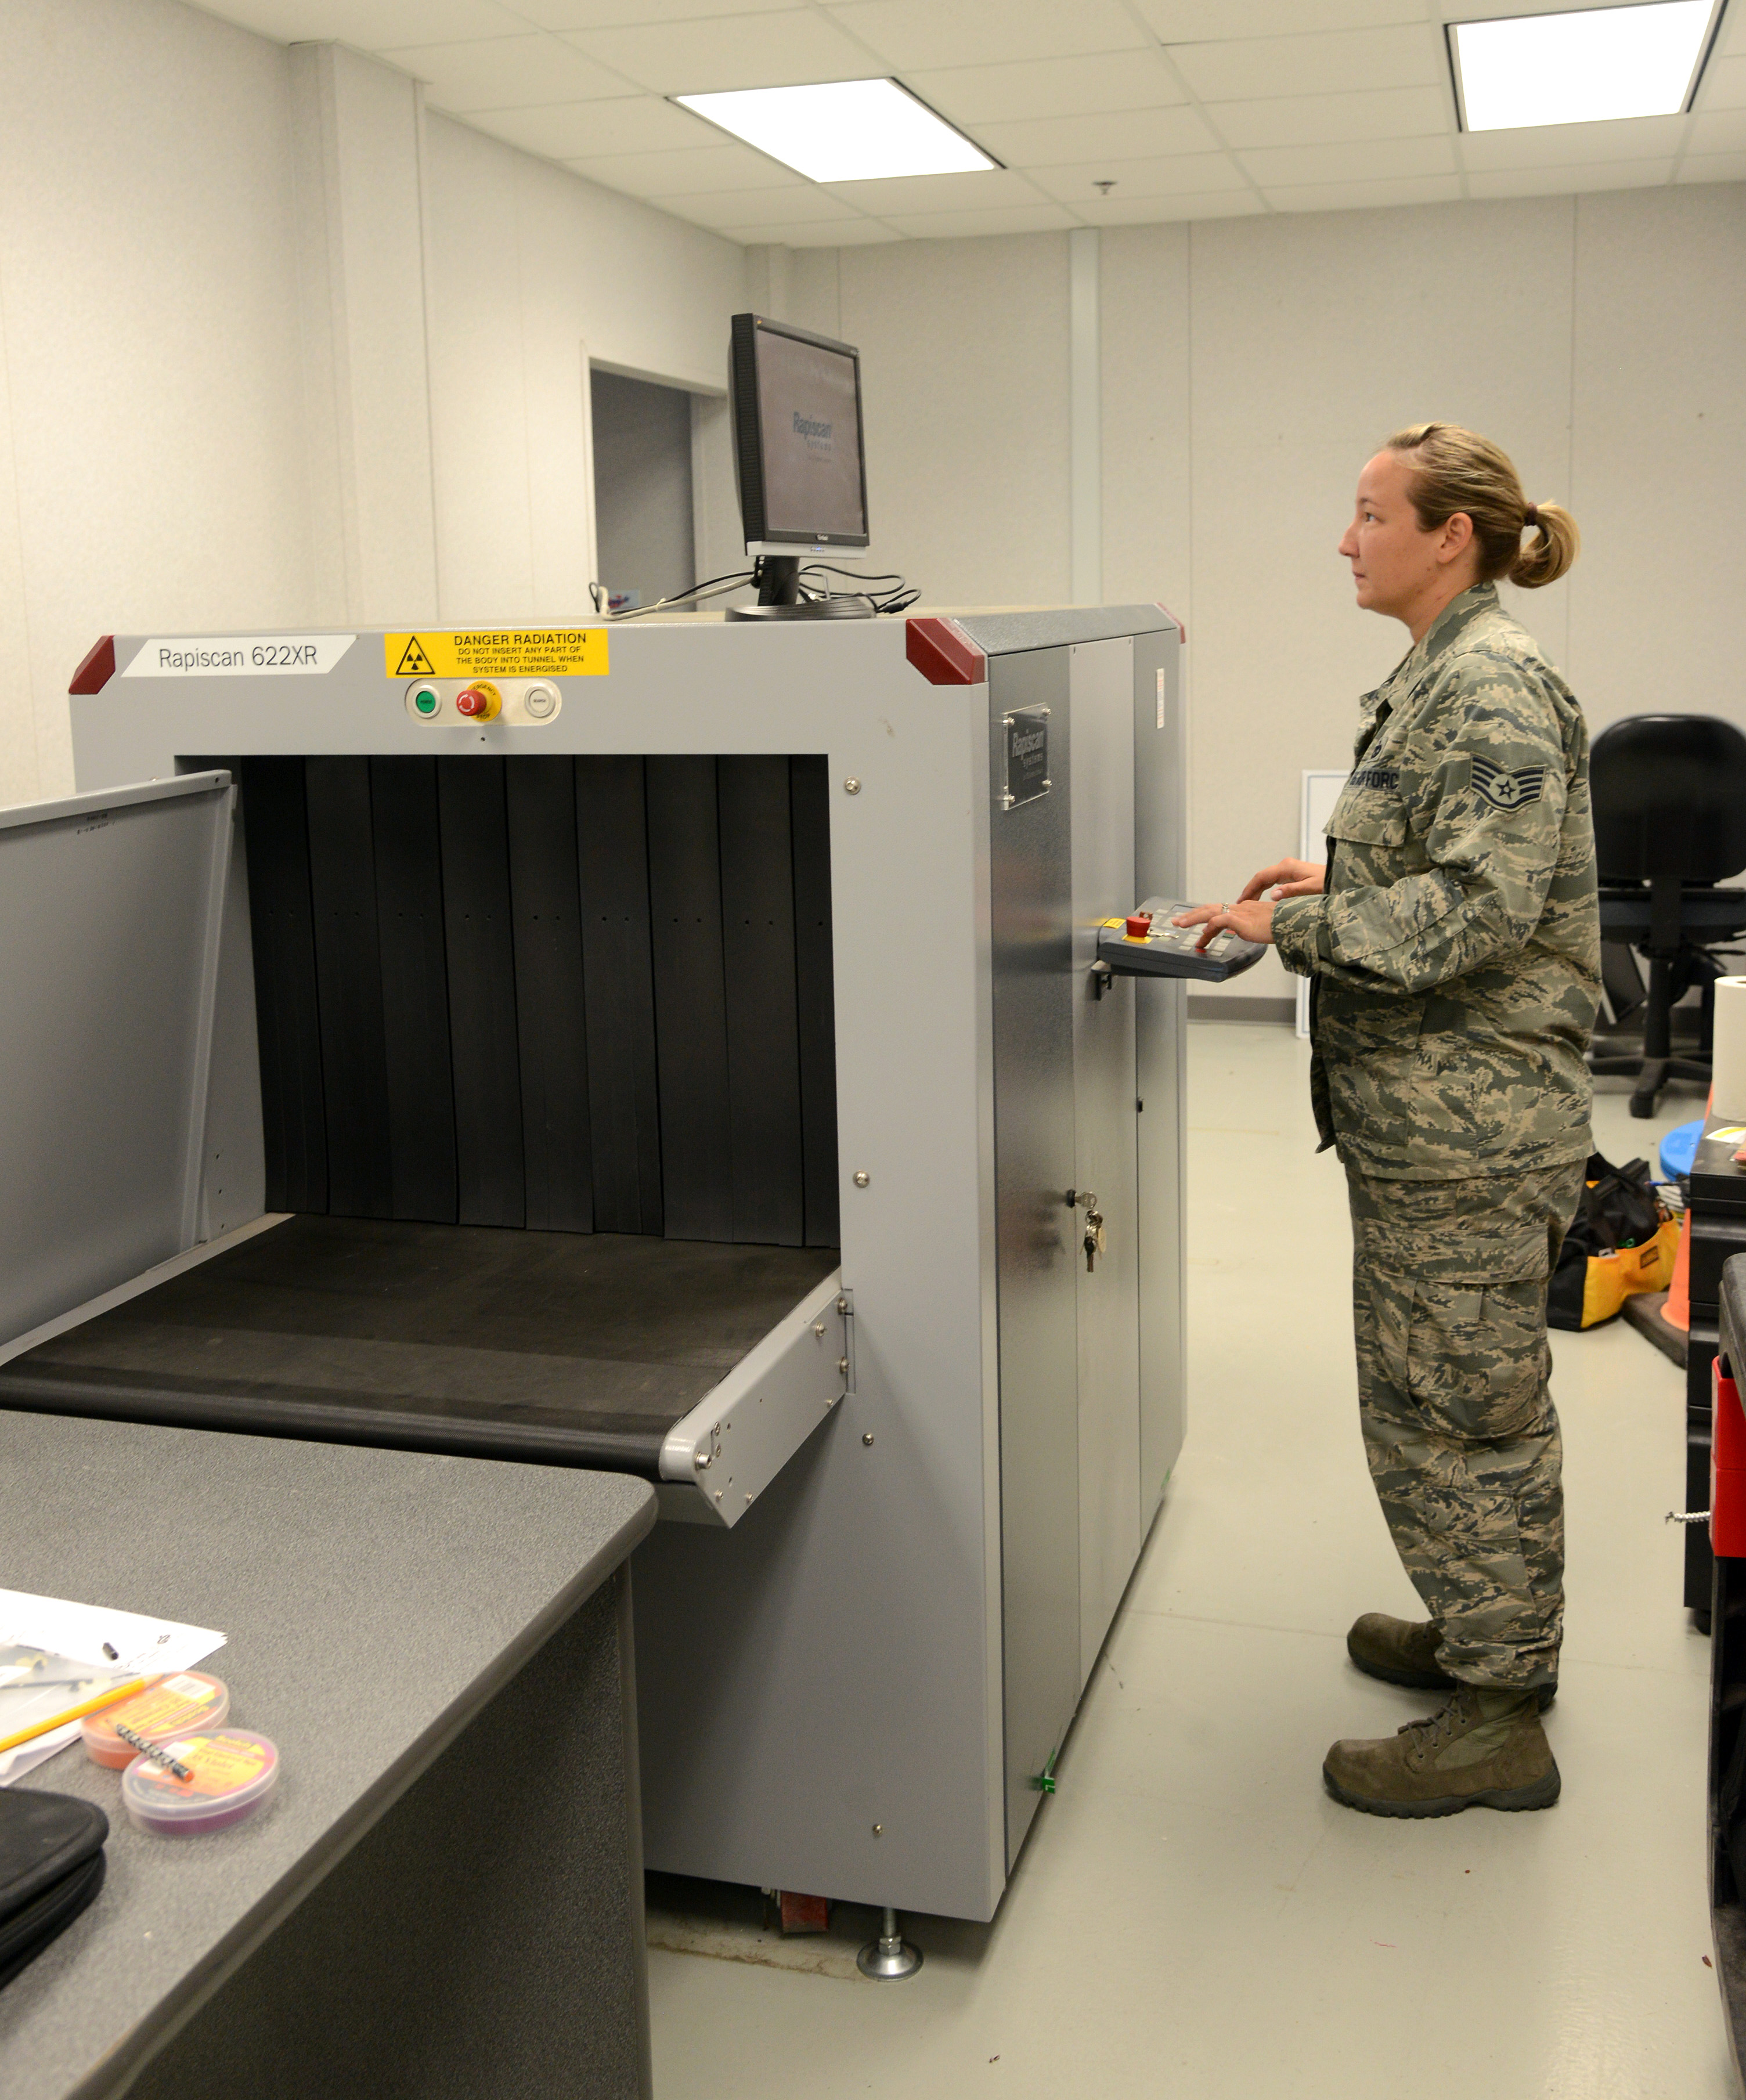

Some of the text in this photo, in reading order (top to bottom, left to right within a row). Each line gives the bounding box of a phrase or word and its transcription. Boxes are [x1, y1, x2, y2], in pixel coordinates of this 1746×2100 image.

[454, 633, 586, 645] DANGER RADIATION
[159, 645, 318, 672] Rapiscan 622XR
